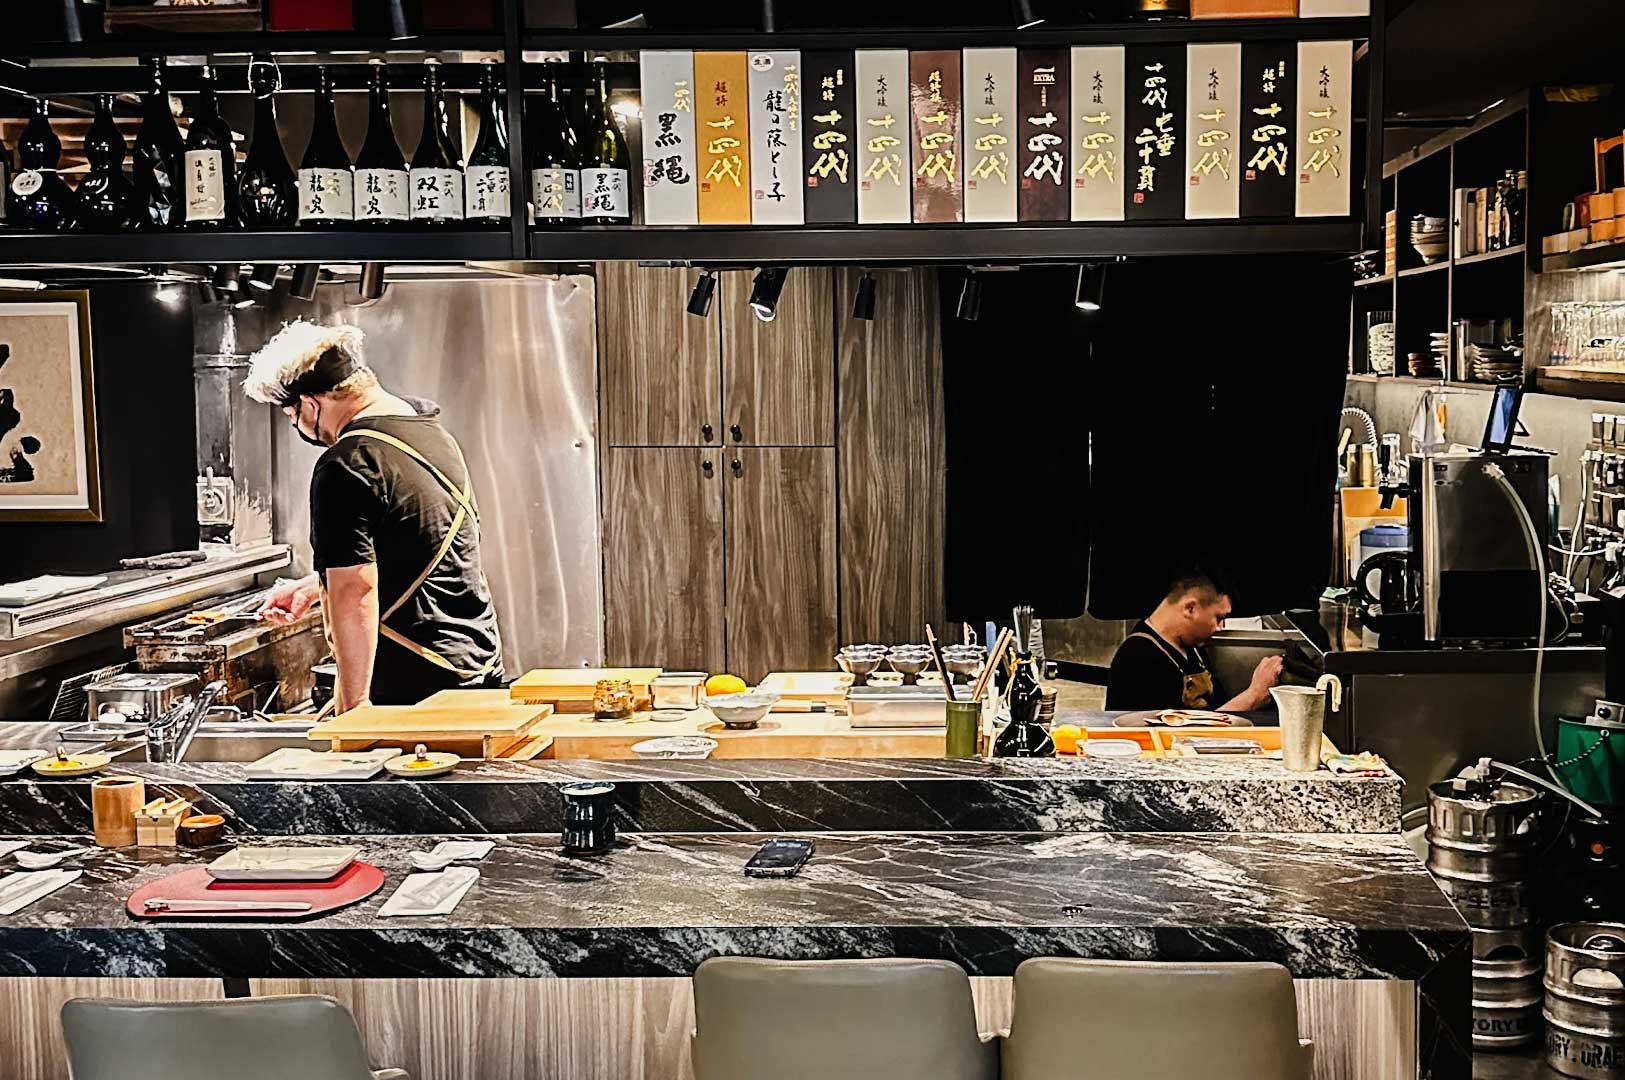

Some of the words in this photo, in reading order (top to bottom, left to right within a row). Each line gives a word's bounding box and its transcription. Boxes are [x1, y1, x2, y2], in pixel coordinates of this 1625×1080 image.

[673, 80, 691, 113] 十四代
[1033, 73, 1055, 82] EXTRA
[1142, 62, 1168, 109] 十四代
[704, 115, 742, 187] 十四代
[809, 109, 849, 184] 十四代
[864, 113, 901, 186] 十四代
[918, 110, 955, 183] 十四代
[971, 111, 1009, 185] 十四代
[1024, 111, 1063, 186] 十四代
[1079, 111, 1117, 185] 十四代
[1193, 107, 1232, 181] 十四代
[1247, 102, 1288, 176] 十四代
[1303, 106, 1341, 179] 十四代
[417, 175, 439, 210] 双虹
